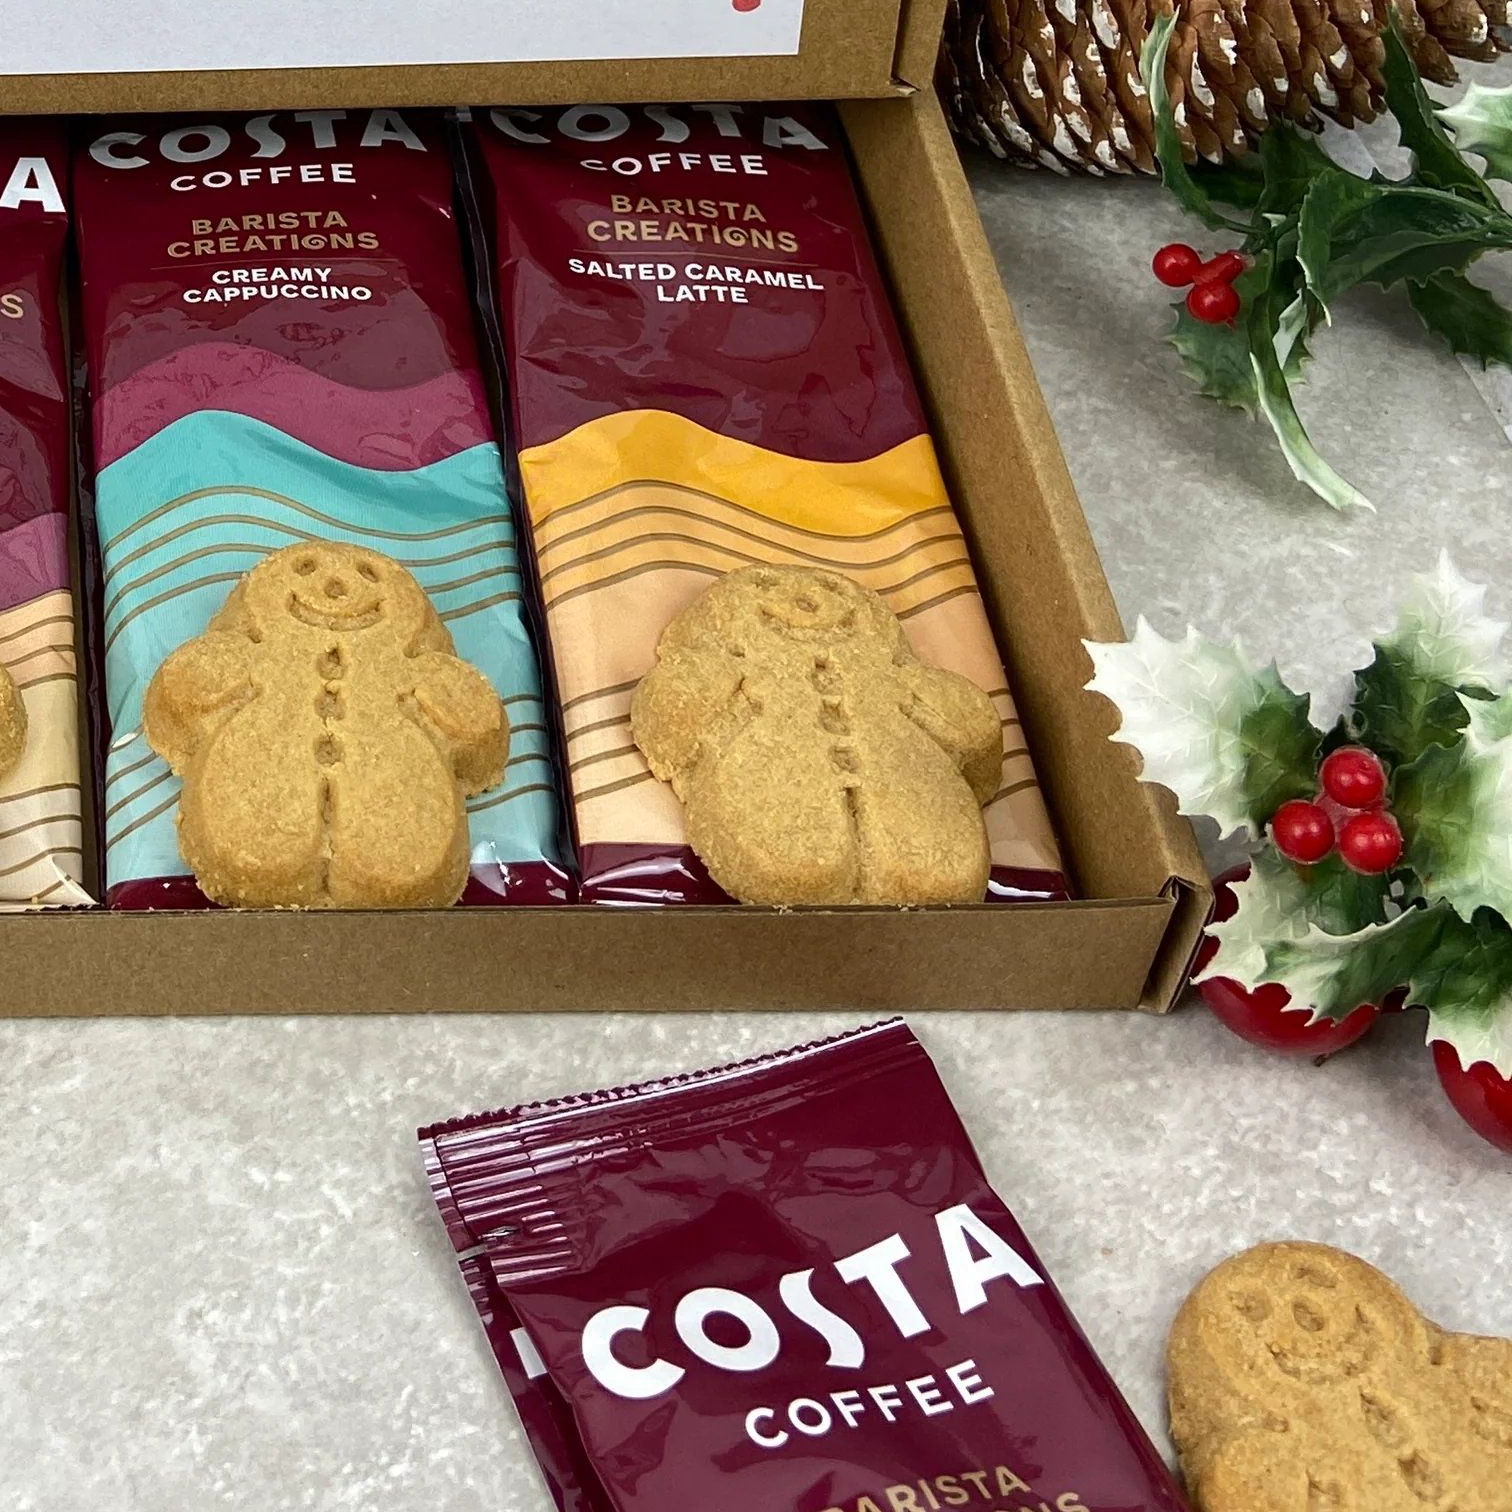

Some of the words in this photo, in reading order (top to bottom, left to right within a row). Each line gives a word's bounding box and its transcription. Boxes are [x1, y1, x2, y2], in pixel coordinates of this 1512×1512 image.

[88, 110, 428, 169] COSTA
[489, 104, 829, 150] COSTA
[170, 163, 356, 191] COFFEE
[580, 152, 768, 176] COFFEE
[191, 210, 349, 236] BARISTA
[610, 194, 767, 223] BARISTA
[166, 232, 380, 258] CREATIONS
[587, 220, 799, 253] CREATIONS
[211, 266, 332, 285] CREAMY
[568, 258, 677, 281] SALTED
[684, 263, 824, 290] CARAMEL
[183, 285, 373, 303] CAPPUCCINO
[657, 285, 749, 303] LATTE
[581, 1203, 1046, 1400] COSTA
[744, 1358, 996, 1448] COFFEE
[820, 1465, 1031, 1512] RISTA
